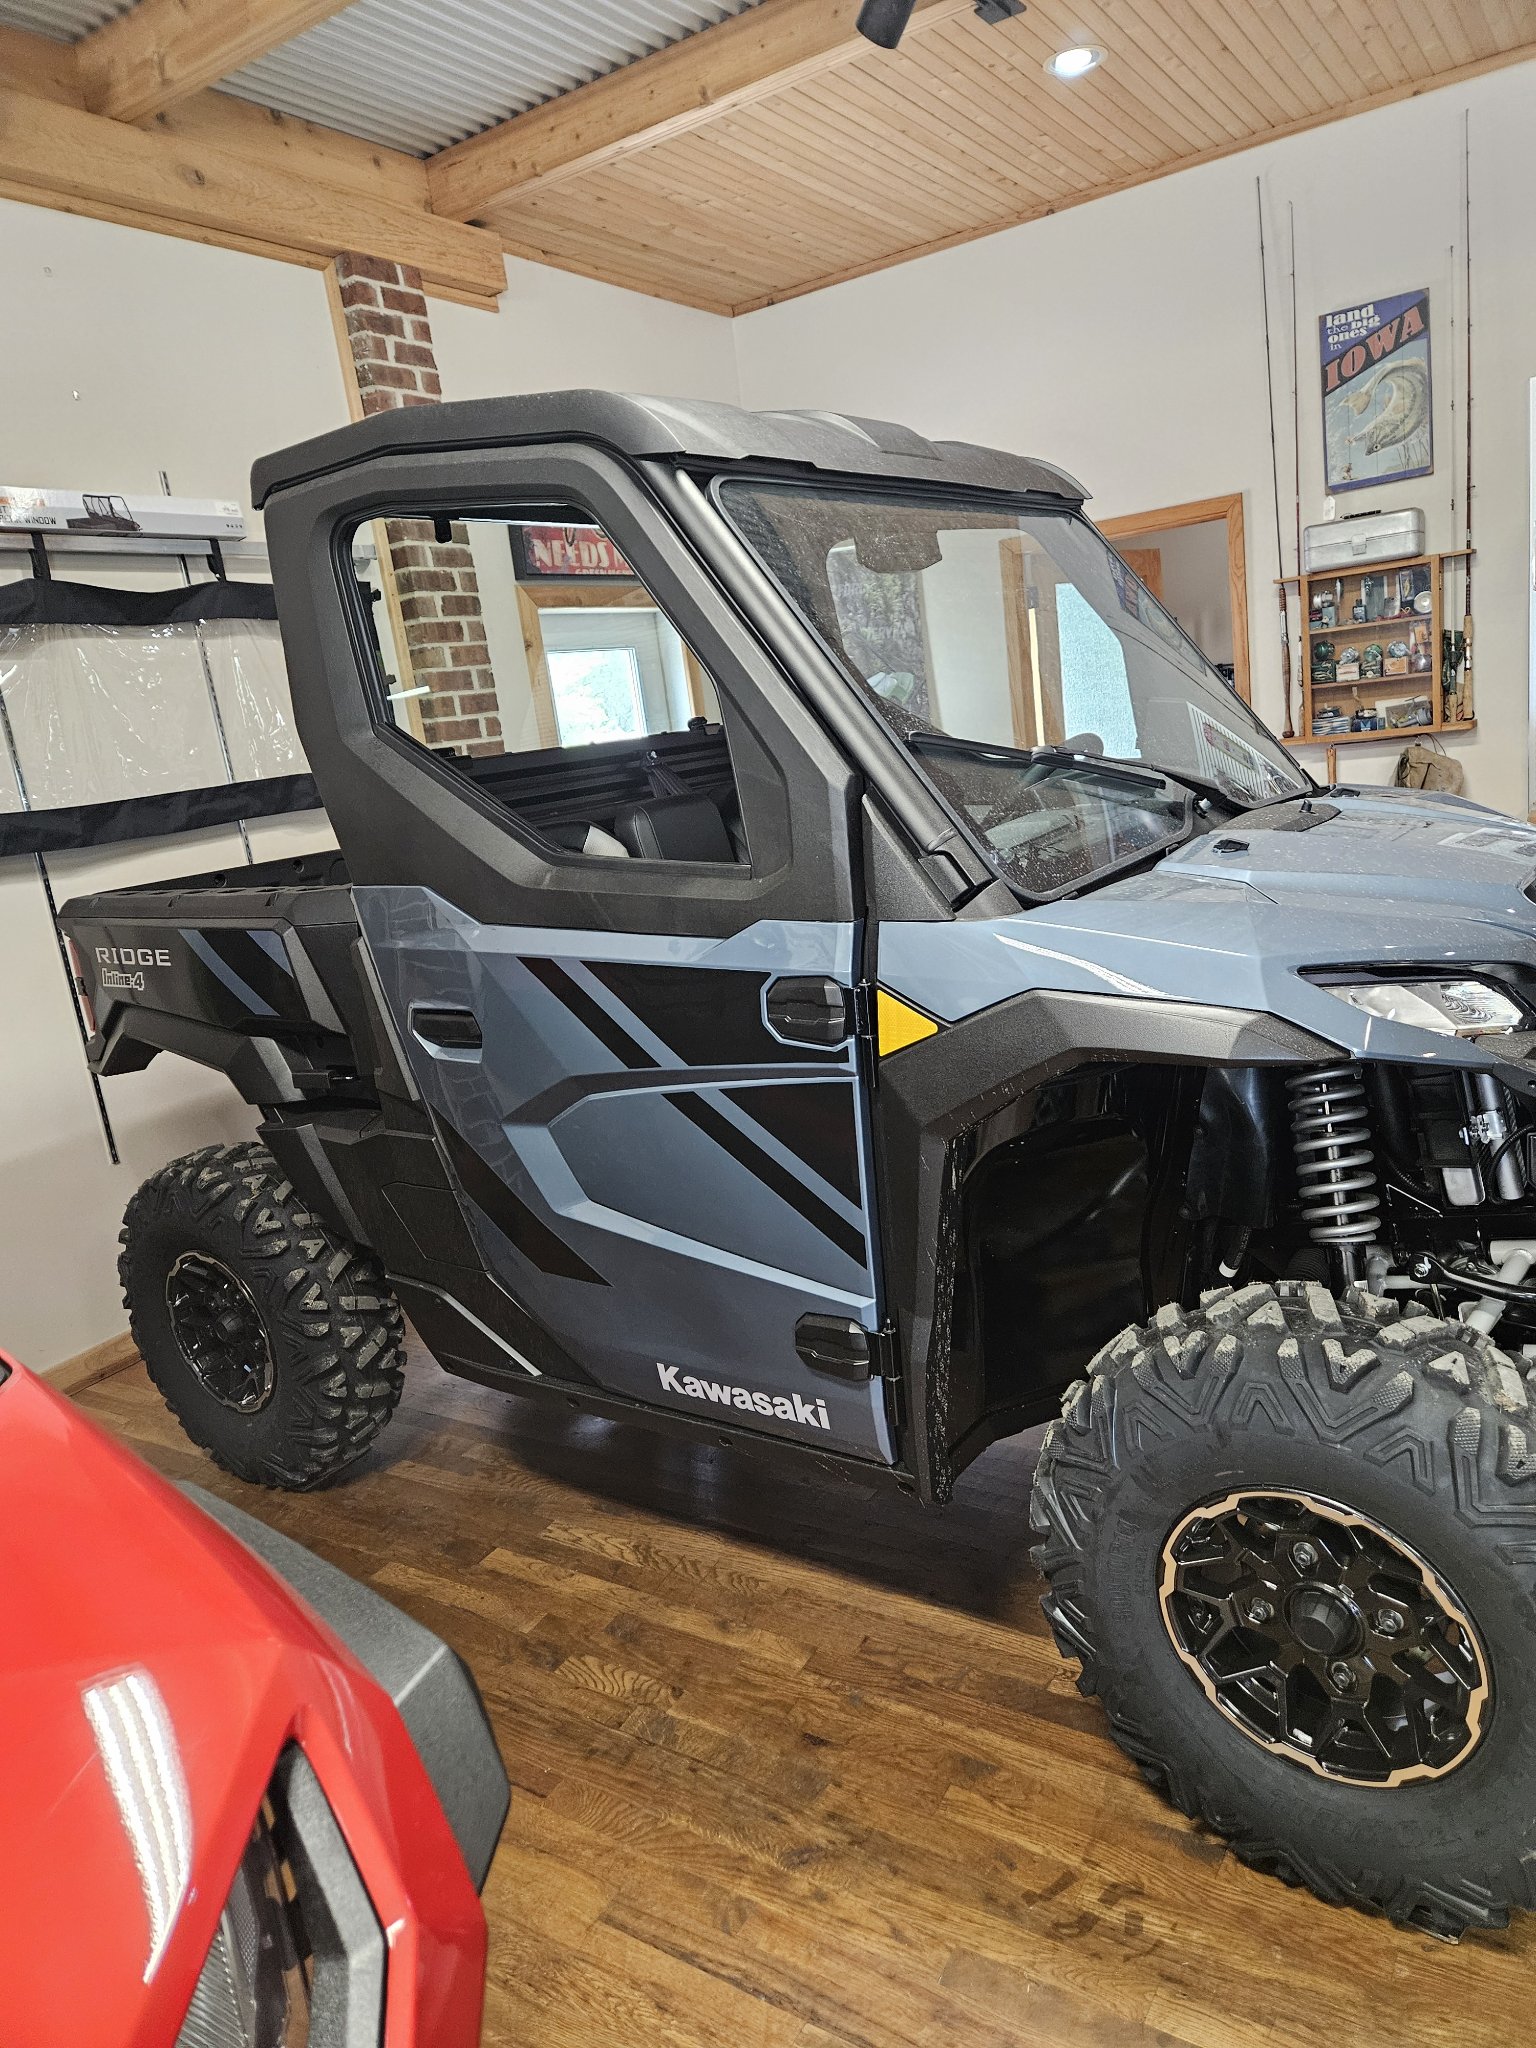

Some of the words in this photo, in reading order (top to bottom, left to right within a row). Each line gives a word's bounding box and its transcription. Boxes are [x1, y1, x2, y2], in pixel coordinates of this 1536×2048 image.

[1325, 303, 1374, 328] land
[1326, 325, 1349, 335] the
[1350, 314, 1381, 330] big
[1327, 326, 1368, 344] ones
[1325, 306, 1425, 392] IOWA
[1329, 343, 1342, 351] in
[24, 516, 57, 525] WINDOW
[532, 538, 610, 568] NEEDS
[95, 947, 172, 967] RIDGE
[102, 967, 145, 991] Inline-4
[656, 1362, 831, 1431] Kawasaki
